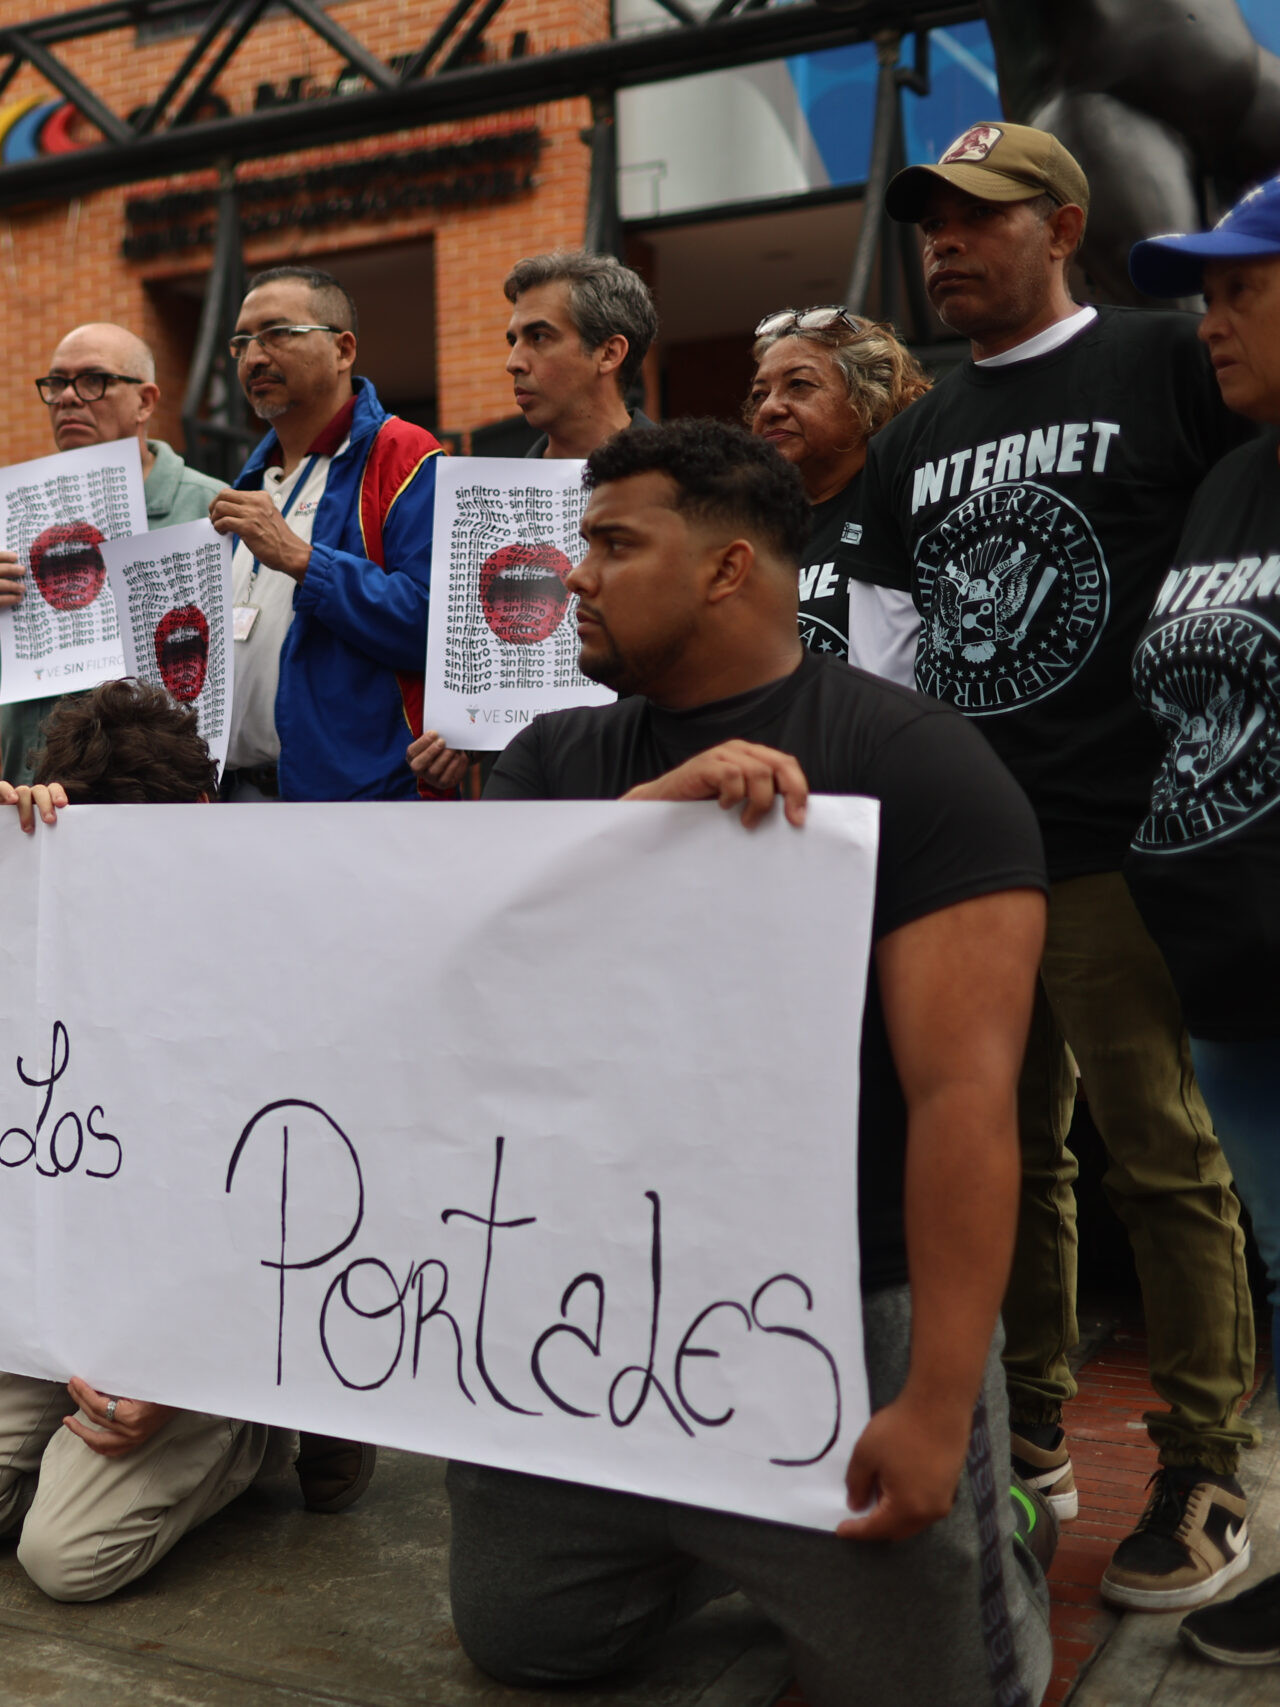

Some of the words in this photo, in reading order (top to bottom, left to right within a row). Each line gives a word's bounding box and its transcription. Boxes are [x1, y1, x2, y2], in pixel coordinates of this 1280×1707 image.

[911, 421, 1120, 515] INTERNET
[940, 487, 1061, 544] ABIERTA
[992, 560, 1013, 575] AYUDA
[1064, 533, 1100, 638] LIBRE
[64, 662, 84, 675] SIN
[1141, 615, 1263, 668] ABIERTA
[924, 649, 1073, 708] NEUTRAL
[483, 710, 501, 723] VE
[505, 710, 529, 723] SIN
